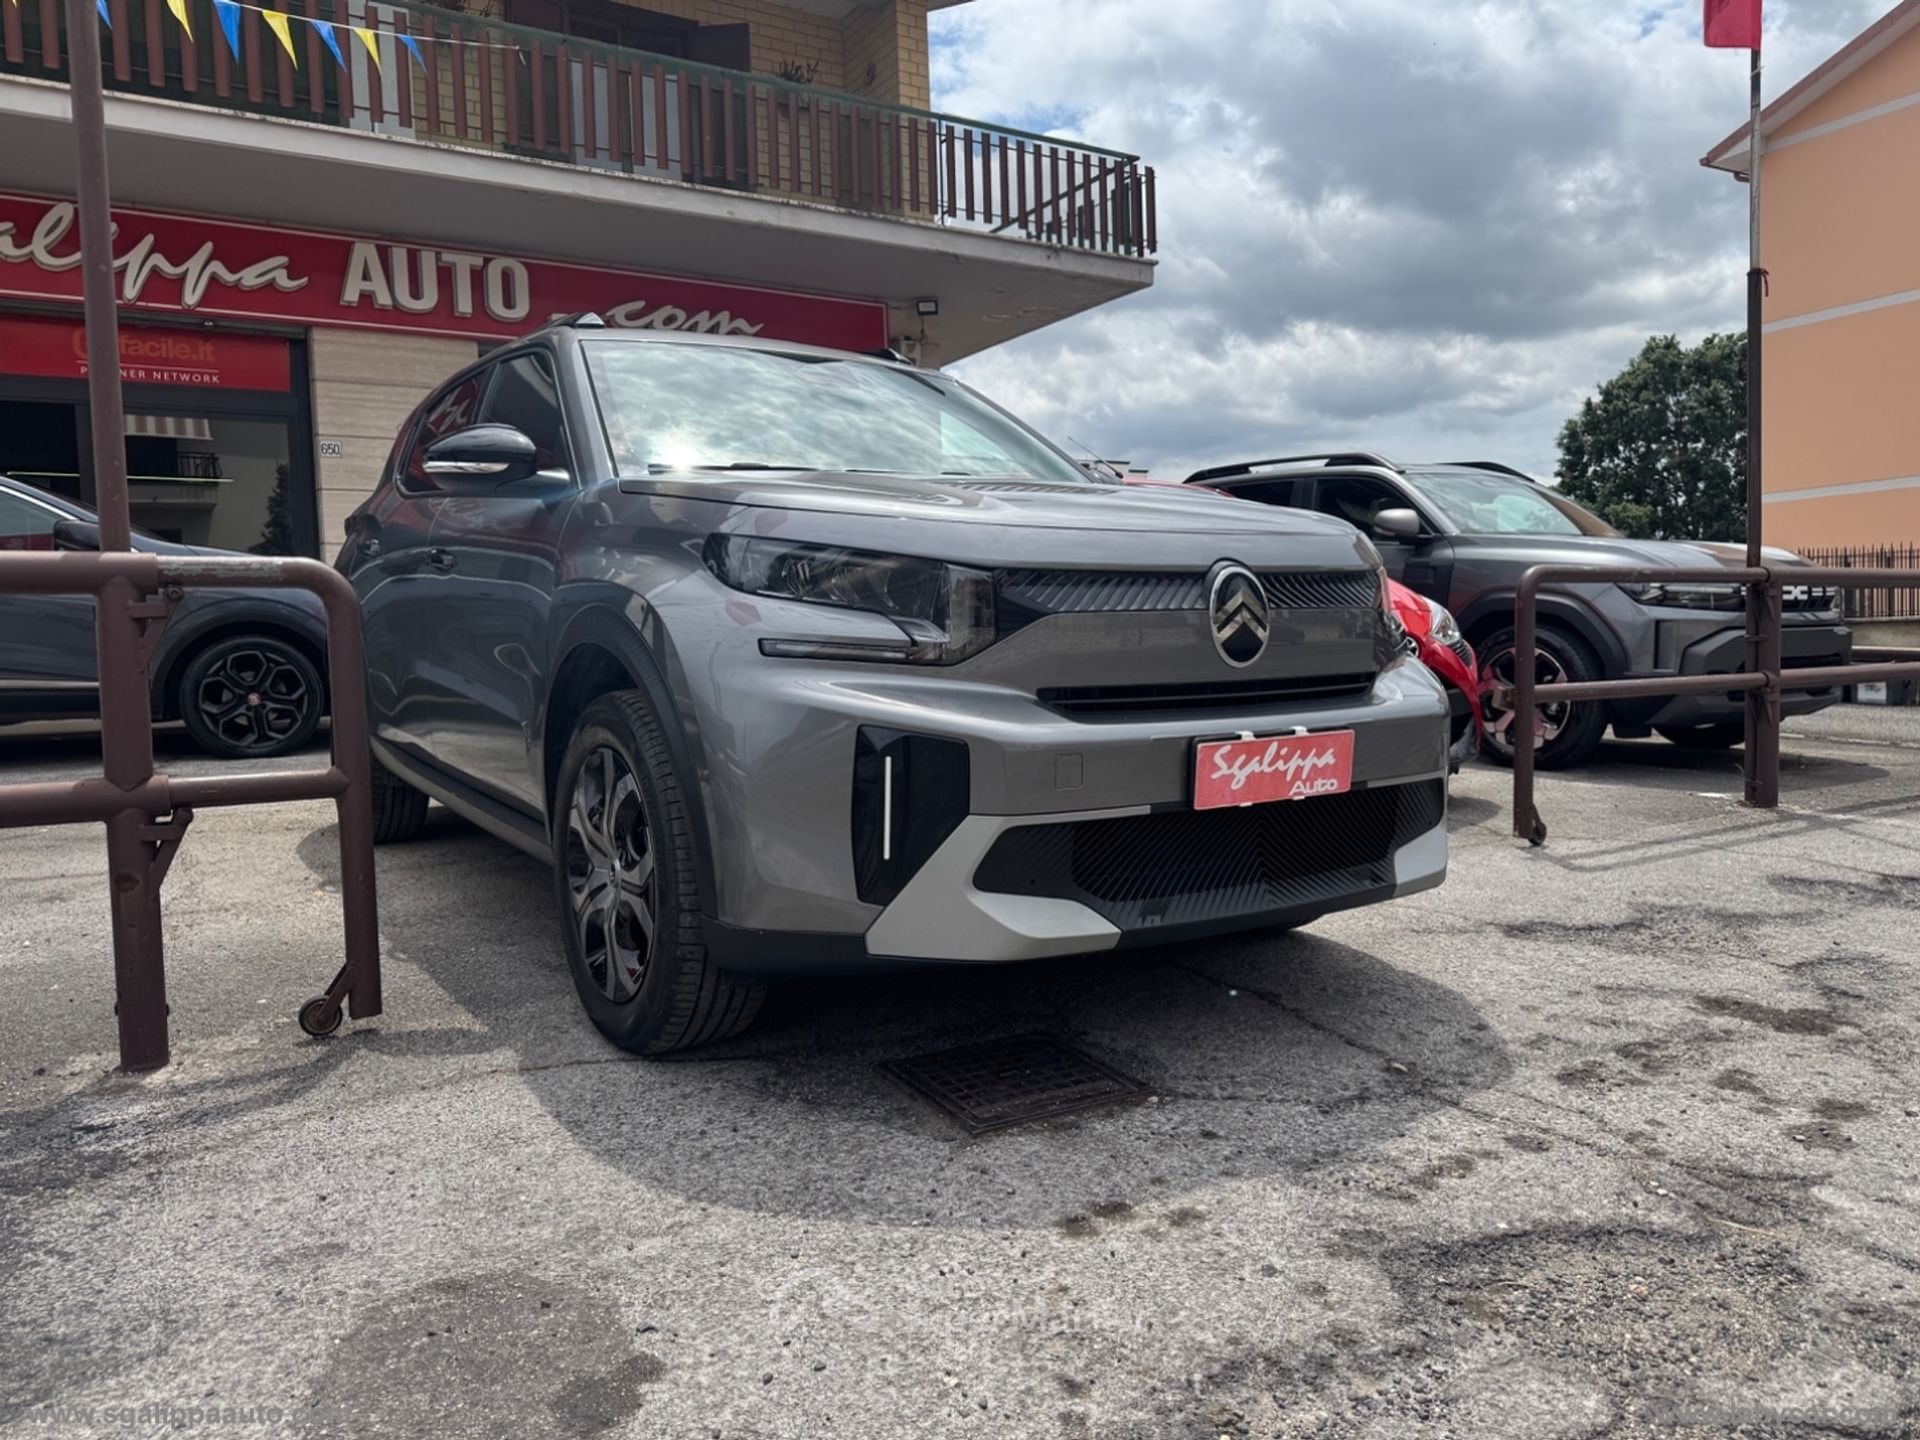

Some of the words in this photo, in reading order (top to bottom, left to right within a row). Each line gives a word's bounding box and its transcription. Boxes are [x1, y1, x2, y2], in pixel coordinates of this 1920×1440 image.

[0, 201, 308, 308] lppa
[341, 241, 530, 321] AUTO
[80, 366, 146, 380] PNER
[153, 371, 220, 384] NETWORK
[321, 443, 340, 455] 650
[1210, 741, 1336, 790] Sgalippa
[1290, 778, 1337, 795] Auto
